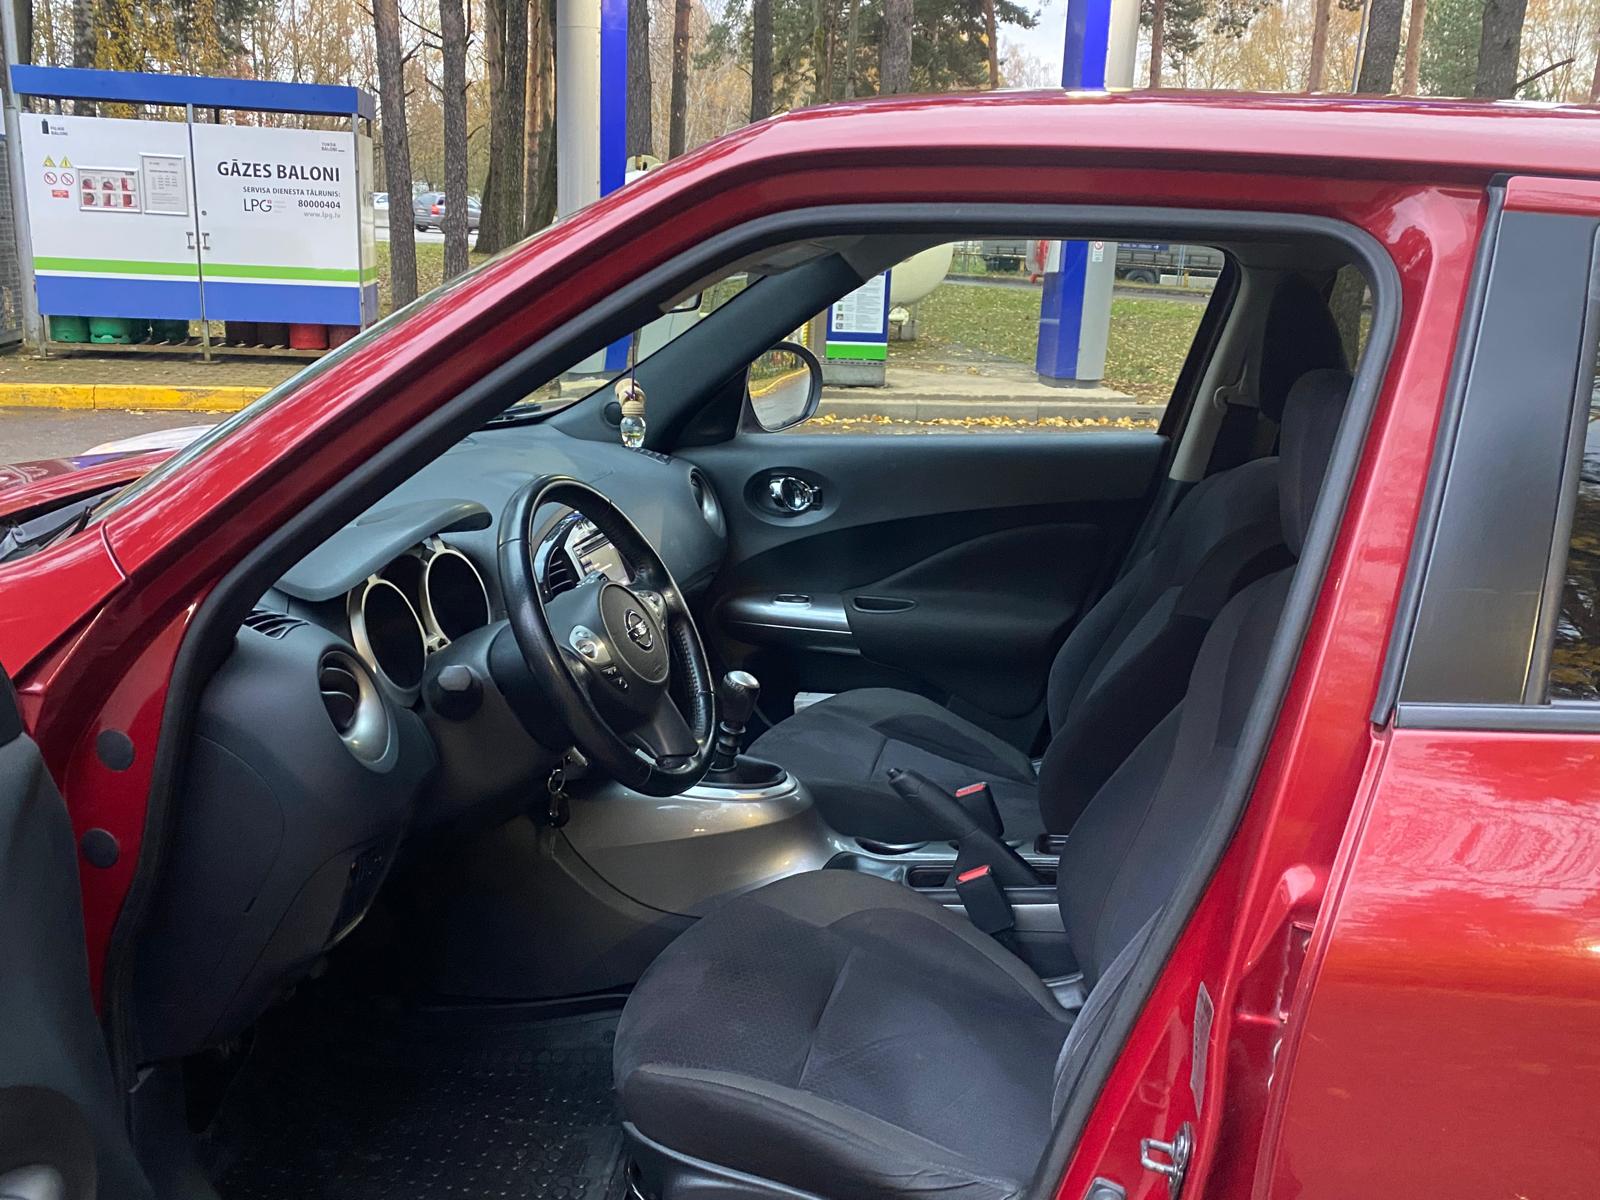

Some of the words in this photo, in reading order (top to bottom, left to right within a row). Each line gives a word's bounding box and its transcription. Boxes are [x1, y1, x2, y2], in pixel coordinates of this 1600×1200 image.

[217, 159, 272, 178] GĀZES
[276, 164, 340, 182] BALONI
[243, 186, 271, 194] SERVISA
[272, 187, 305, 196] DIENESTA
[243, 198, 272, 213] LPG
[298, 199, 341, 209] 80000404
